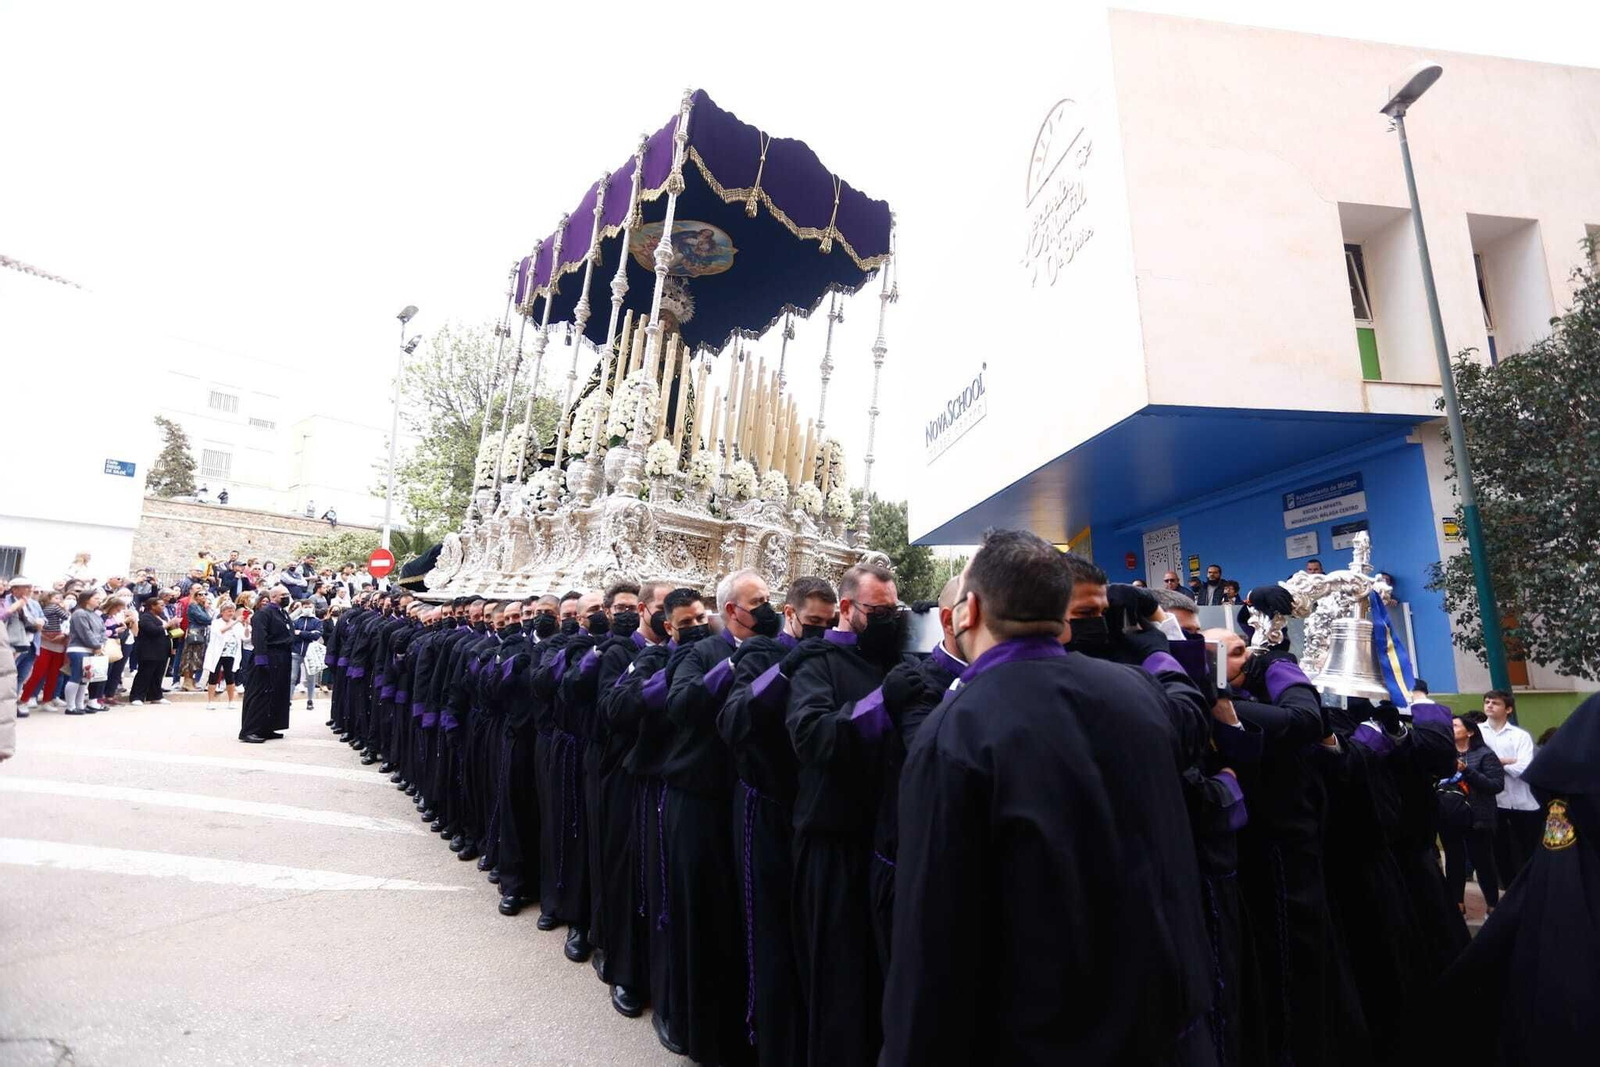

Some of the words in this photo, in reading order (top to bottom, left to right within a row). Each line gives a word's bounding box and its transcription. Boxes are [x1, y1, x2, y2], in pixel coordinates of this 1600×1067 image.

[925, 372, 986, 448] NOVASCHOOL
[1296, 486, 1329, 500] Ayuntamiento
[1337, 480, 1357, 489] Málaga
[1291, 514, 1318, 525] NOVASCHOOL
[1339, 504, 1360, 514] CENTRO
[1302, 506, 1322, 515] ESCUELA
[1322, 501, 1343, 510] INFANTIL
